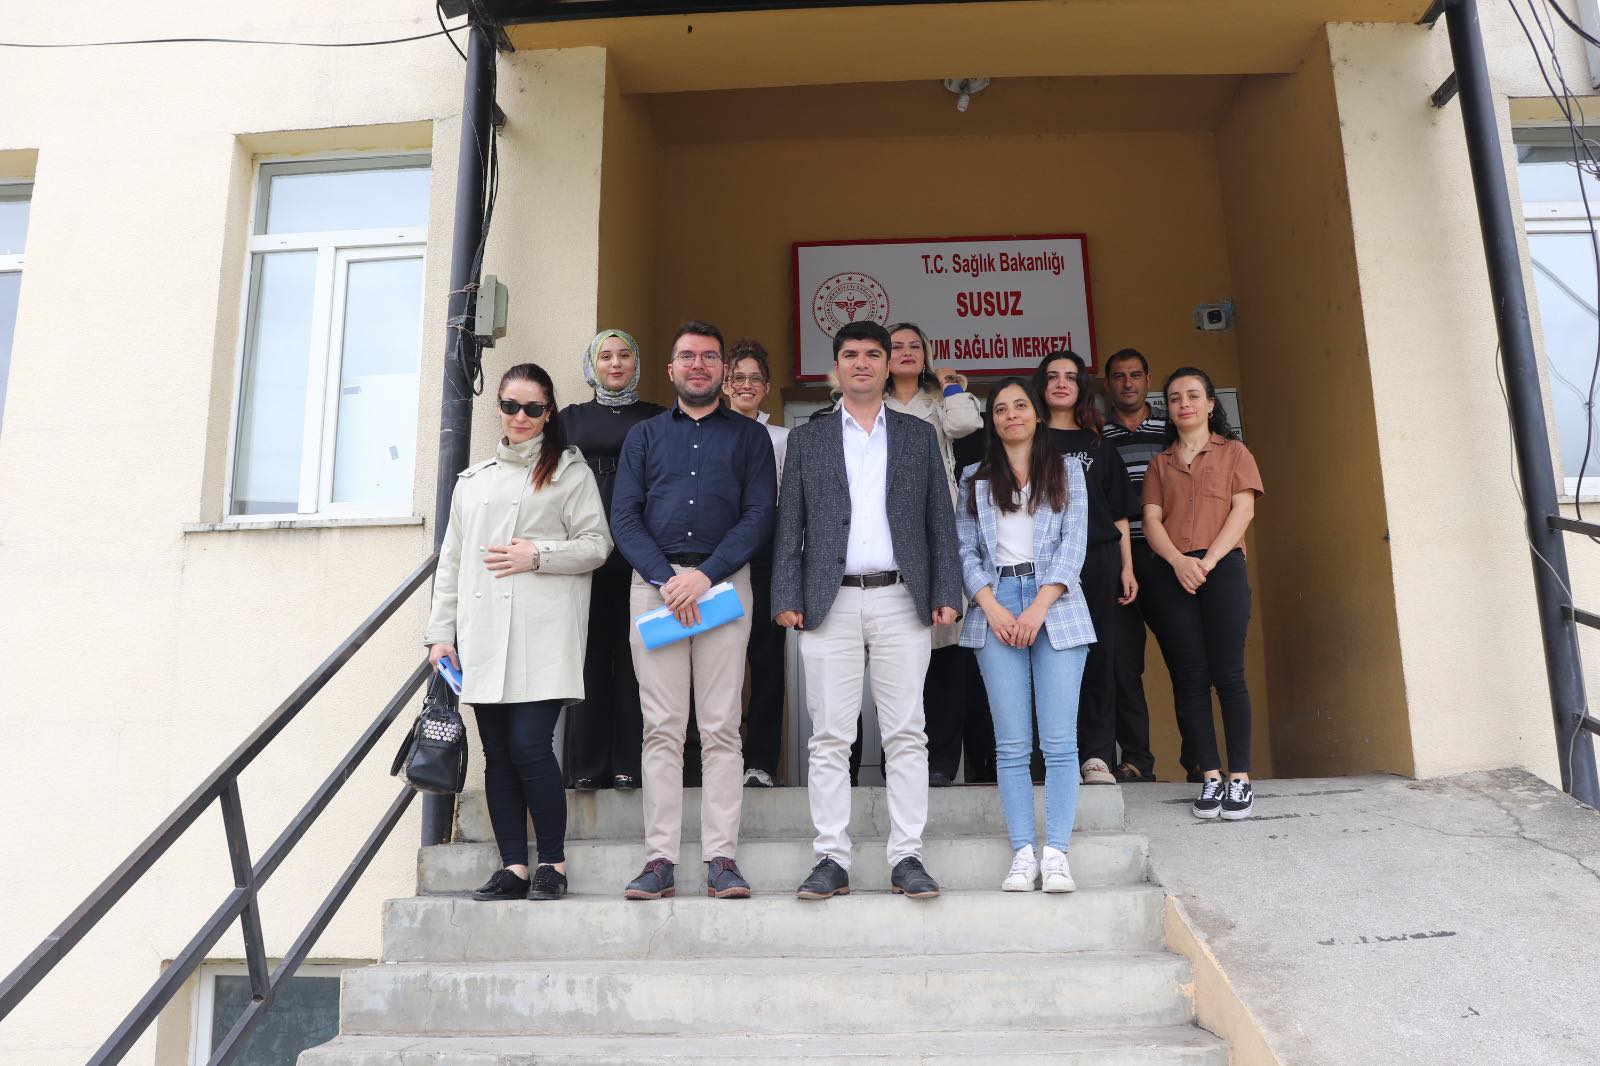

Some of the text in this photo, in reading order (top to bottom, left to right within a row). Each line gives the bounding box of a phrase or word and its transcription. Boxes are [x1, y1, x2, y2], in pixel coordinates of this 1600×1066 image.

[921, 251, 1065, 278] T.C. Sağlık Bakanlığı
[956, 290, 1024, 318] SUSUZ
[929, 331, 1072, 361] UM SAĞLIĞI MERKEZİ
